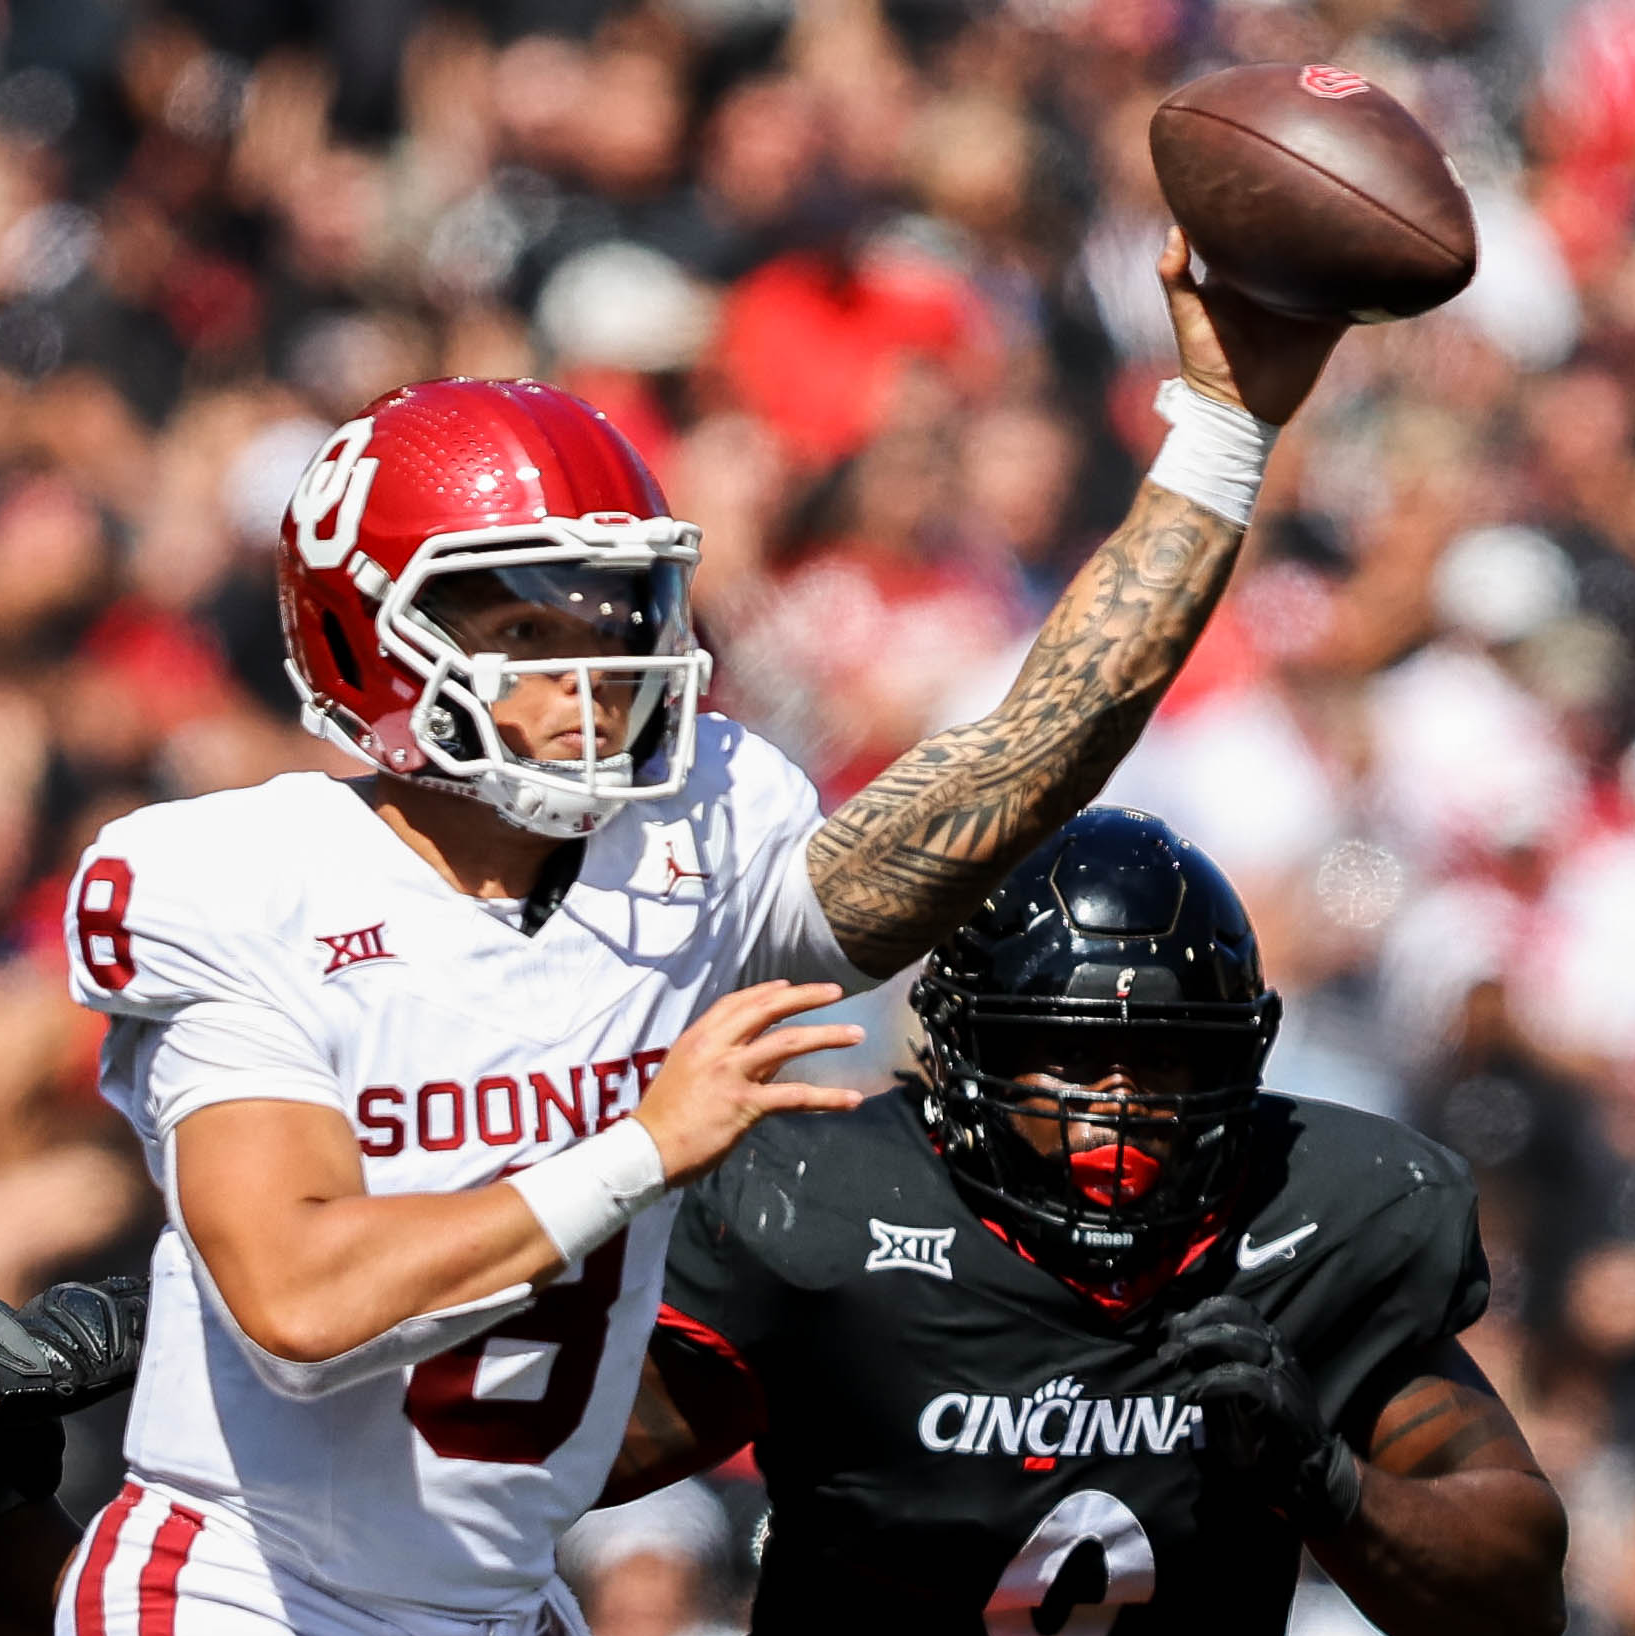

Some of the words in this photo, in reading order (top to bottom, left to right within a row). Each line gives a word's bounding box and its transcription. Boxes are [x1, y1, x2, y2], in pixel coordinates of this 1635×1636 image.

[290, 416, 380, 569] OU
[75, 857, 138, 991] 8
[314, 920, 398, 975] XII
